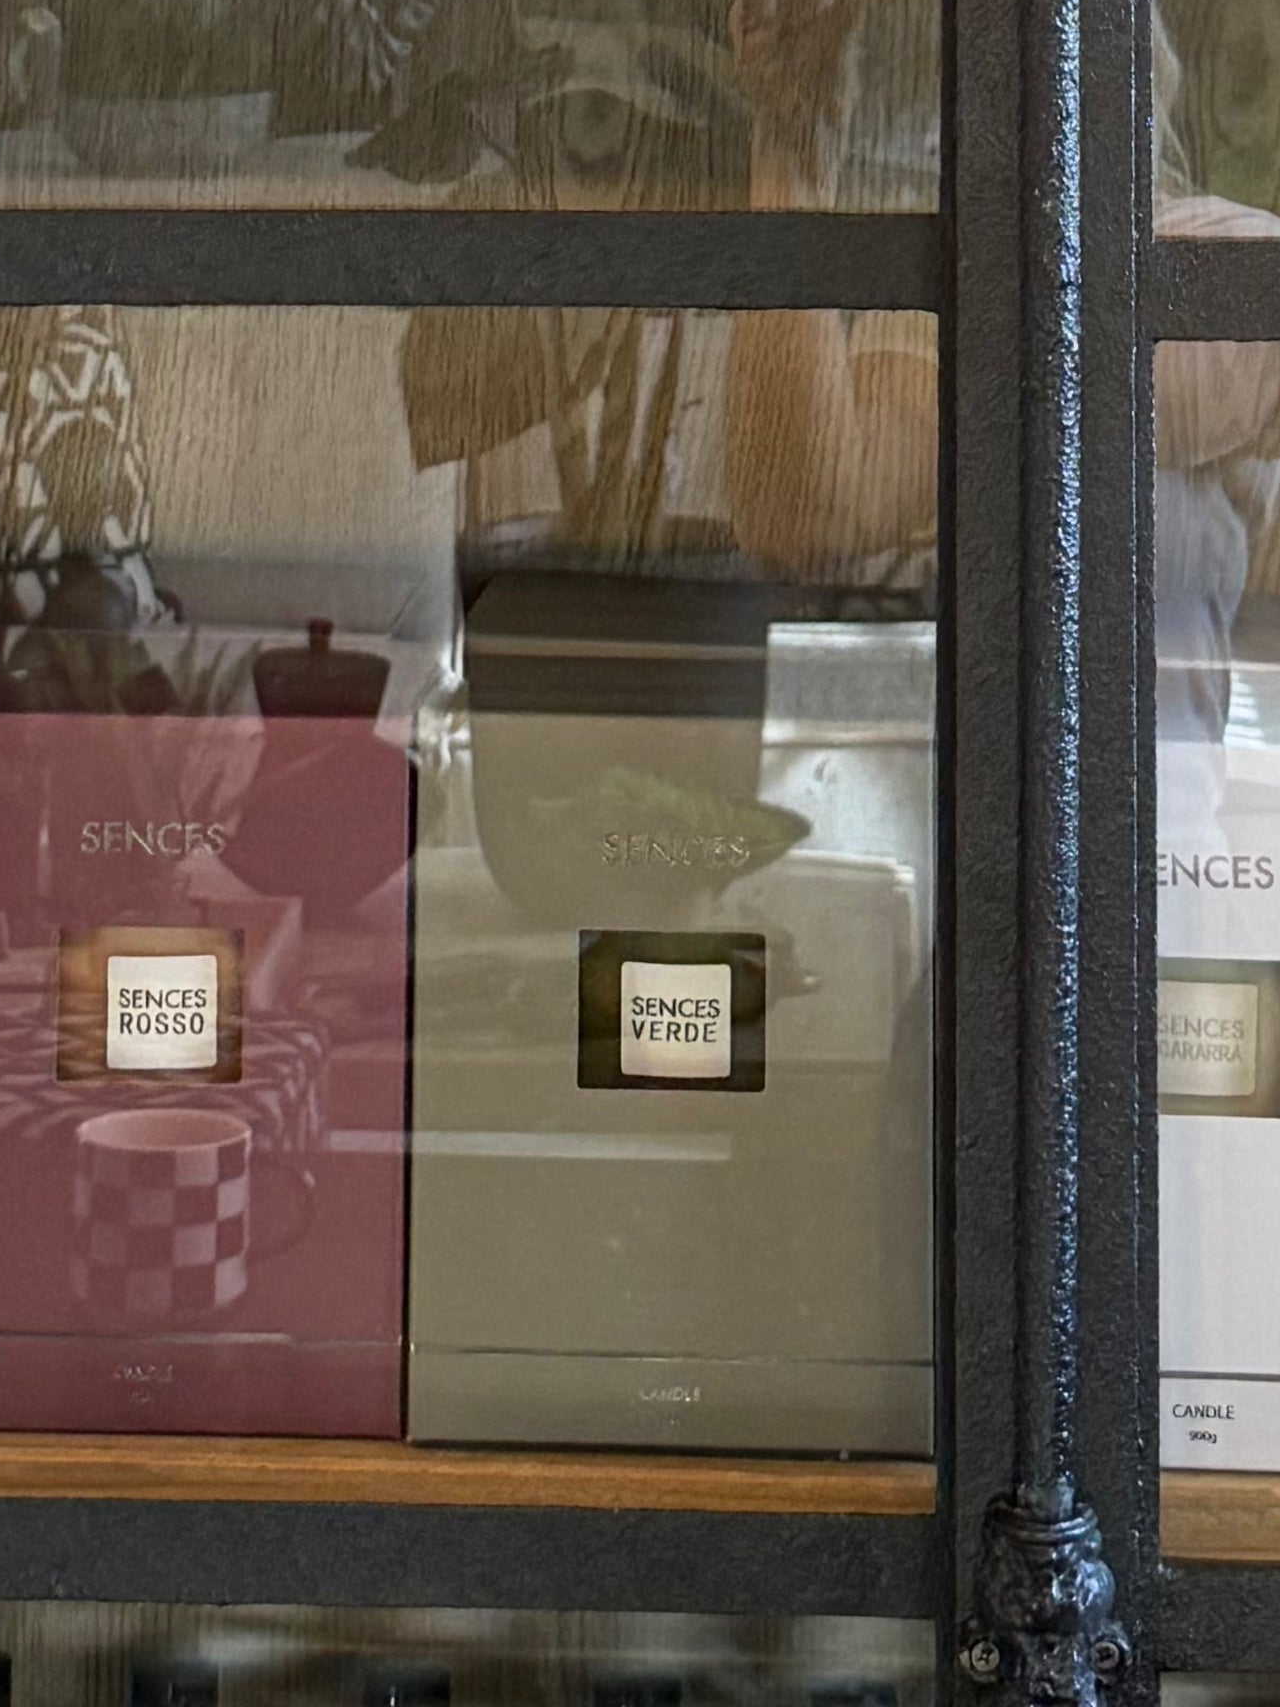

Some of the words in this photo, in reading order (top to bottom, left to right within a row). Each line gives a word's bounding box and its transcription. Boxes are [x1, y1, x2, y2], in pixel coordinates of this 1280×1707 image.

[80, 820, 226, 856] SENCES
[1157, 852, 1275, 890] ENCES
[119, 987, 207, 1010] SENCES
[631, 995, 721, 1019] SENCES
[119, 1011, 205, 1036] ROSSO
[631, 1018, 718, 1044] VERDE
[1172, 1403, 1236, 1421] CANDLE
